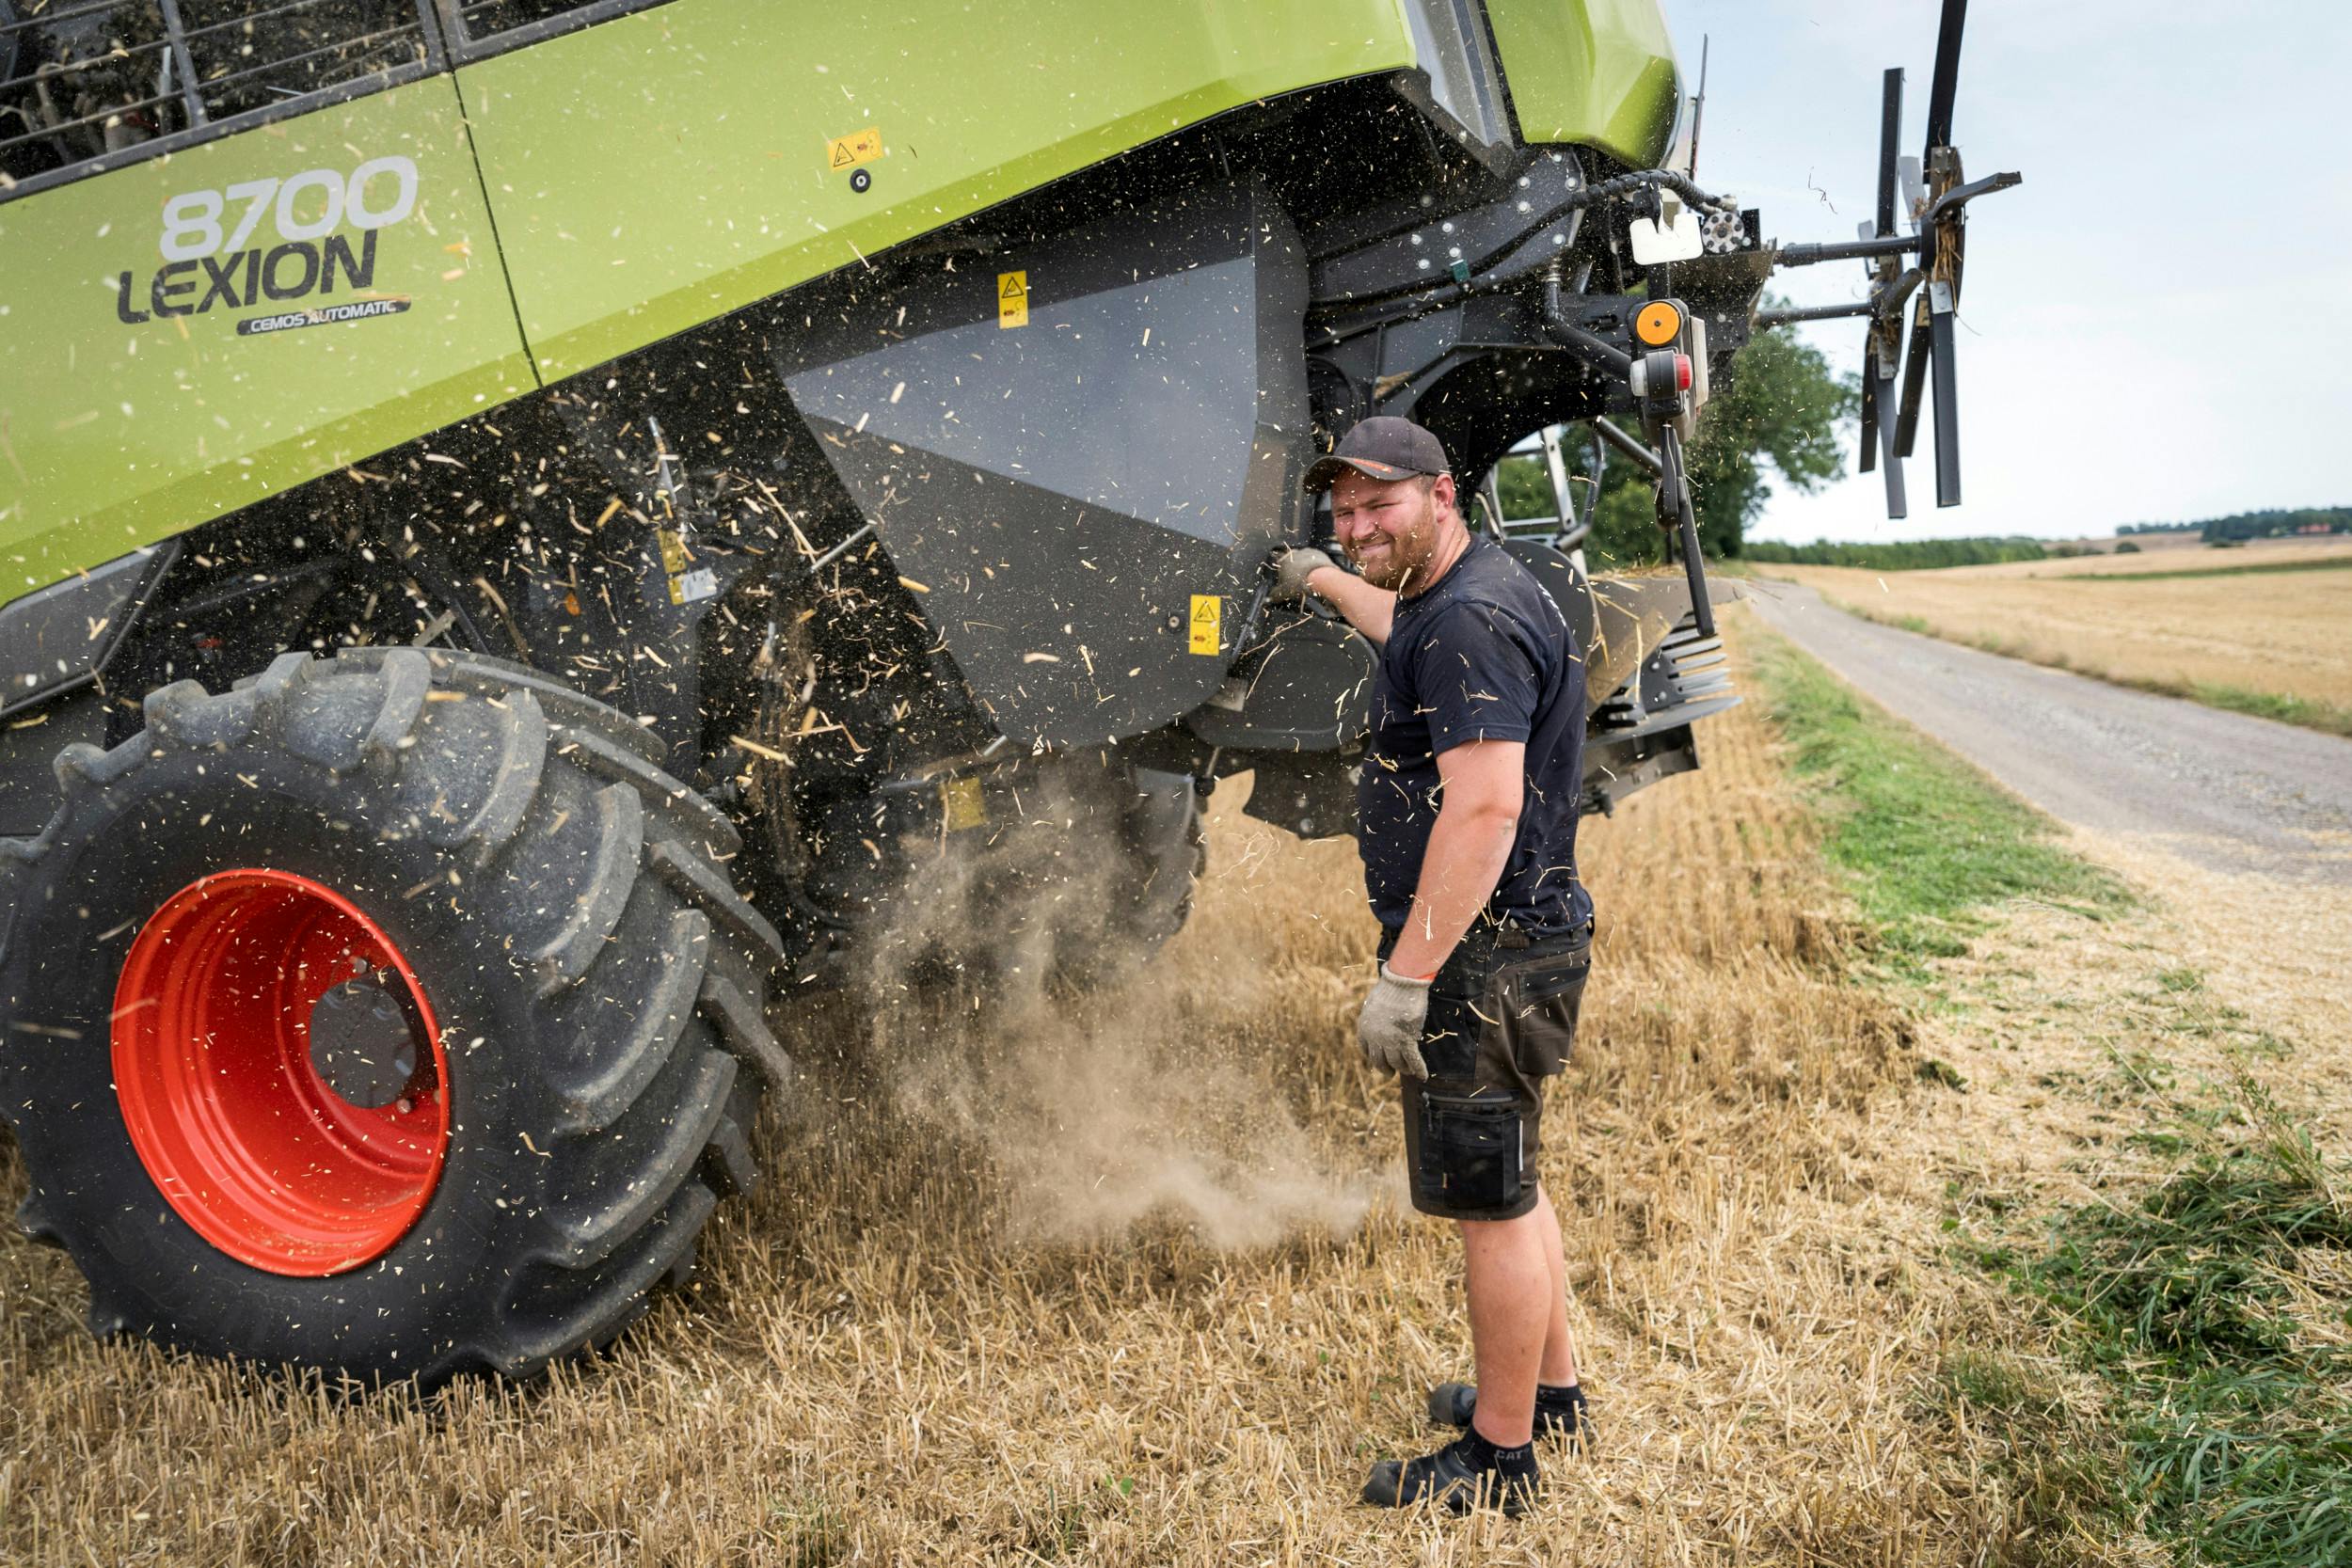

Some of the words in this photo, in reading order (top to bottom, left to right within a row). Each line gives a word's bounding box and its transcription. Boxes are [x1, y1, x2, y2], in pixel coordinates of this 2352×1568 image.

[160, 155, 419, 261] 8700
[117, 229, 378, 325] LEXION
[250, 312, 305, 333] CEMOS
[308, 300, 396, 325] AUTOMATIC
